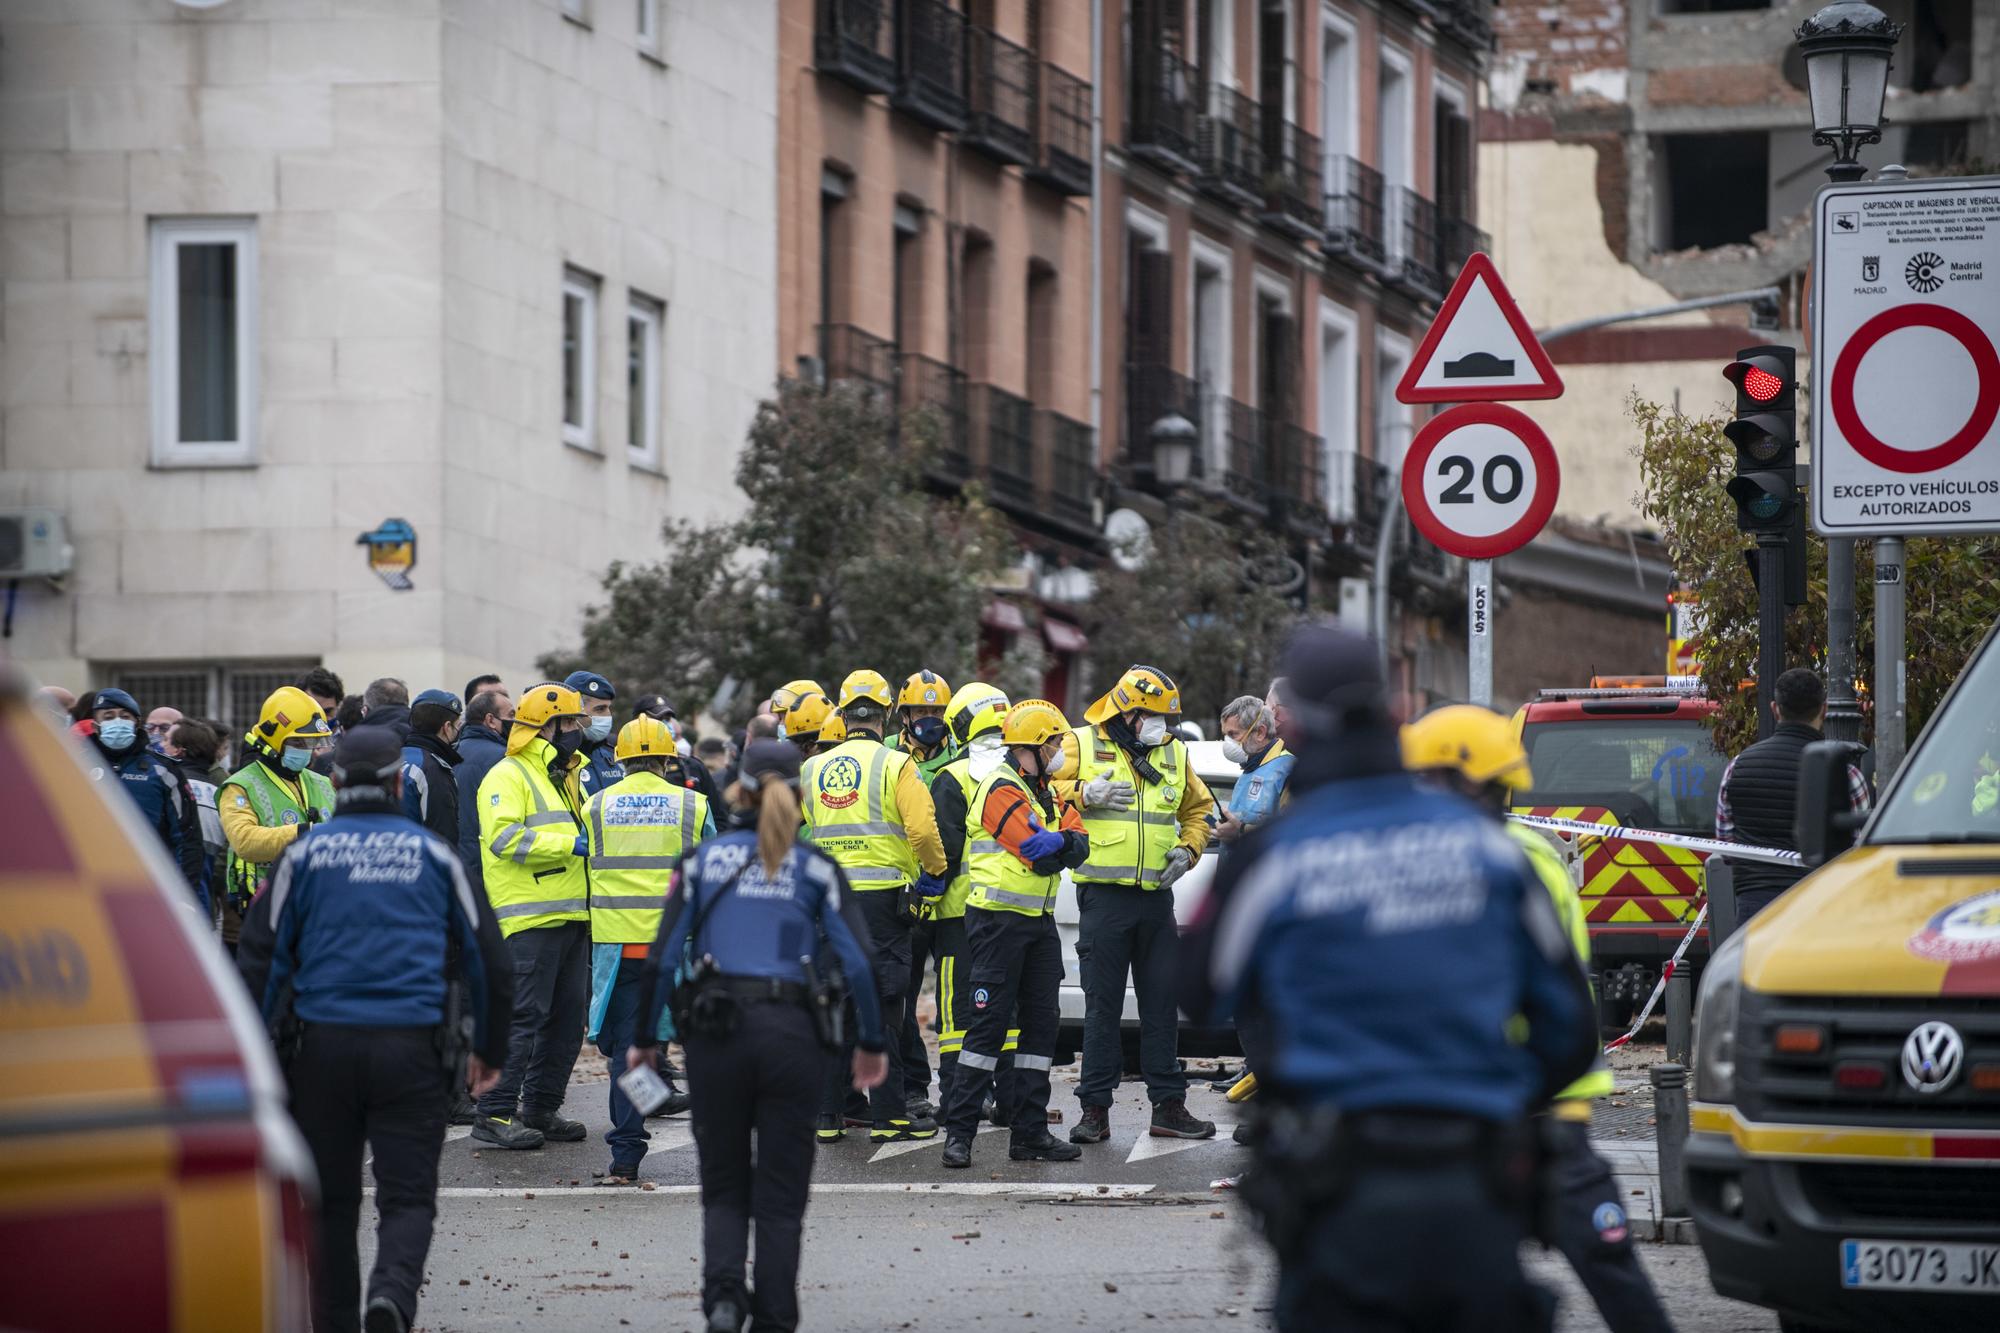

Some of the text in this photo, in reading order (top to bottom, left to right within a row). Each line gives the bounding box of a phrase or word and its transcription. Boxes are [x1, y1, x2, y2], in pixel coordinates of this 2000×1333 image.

[1862, 200, 1902, 210] CAPTACIÓN
[1905, 200, 1914, 208] DE
[1917, 197, 1954, 208] IMÁGENES
[1957, 198, 1967, 206] DE
[1950, 262, 1982, 270] Madrid
[1949, 272, 1983, 281] Central
[1854, 286, 1888, 294] MADRID
[1438, 454, 1524, 505] 20
[1833, 479, 1999, 498] EXCEPTO VEHÍCULOS
[1859, 500, 1971, 516] AUTORIZADOS
[1475, 587, 1486, 633] KORS
[1669, 764, 1706, 799] 112
[616, 796, 669, 807] SAMUR
[648, 817, 677, 825] Madrid
[309, 848, 421, 870] MUNICIPAL
[348, 864, 422, 883] Madrid
[1865, 1246, 1948, 1283] 3073
